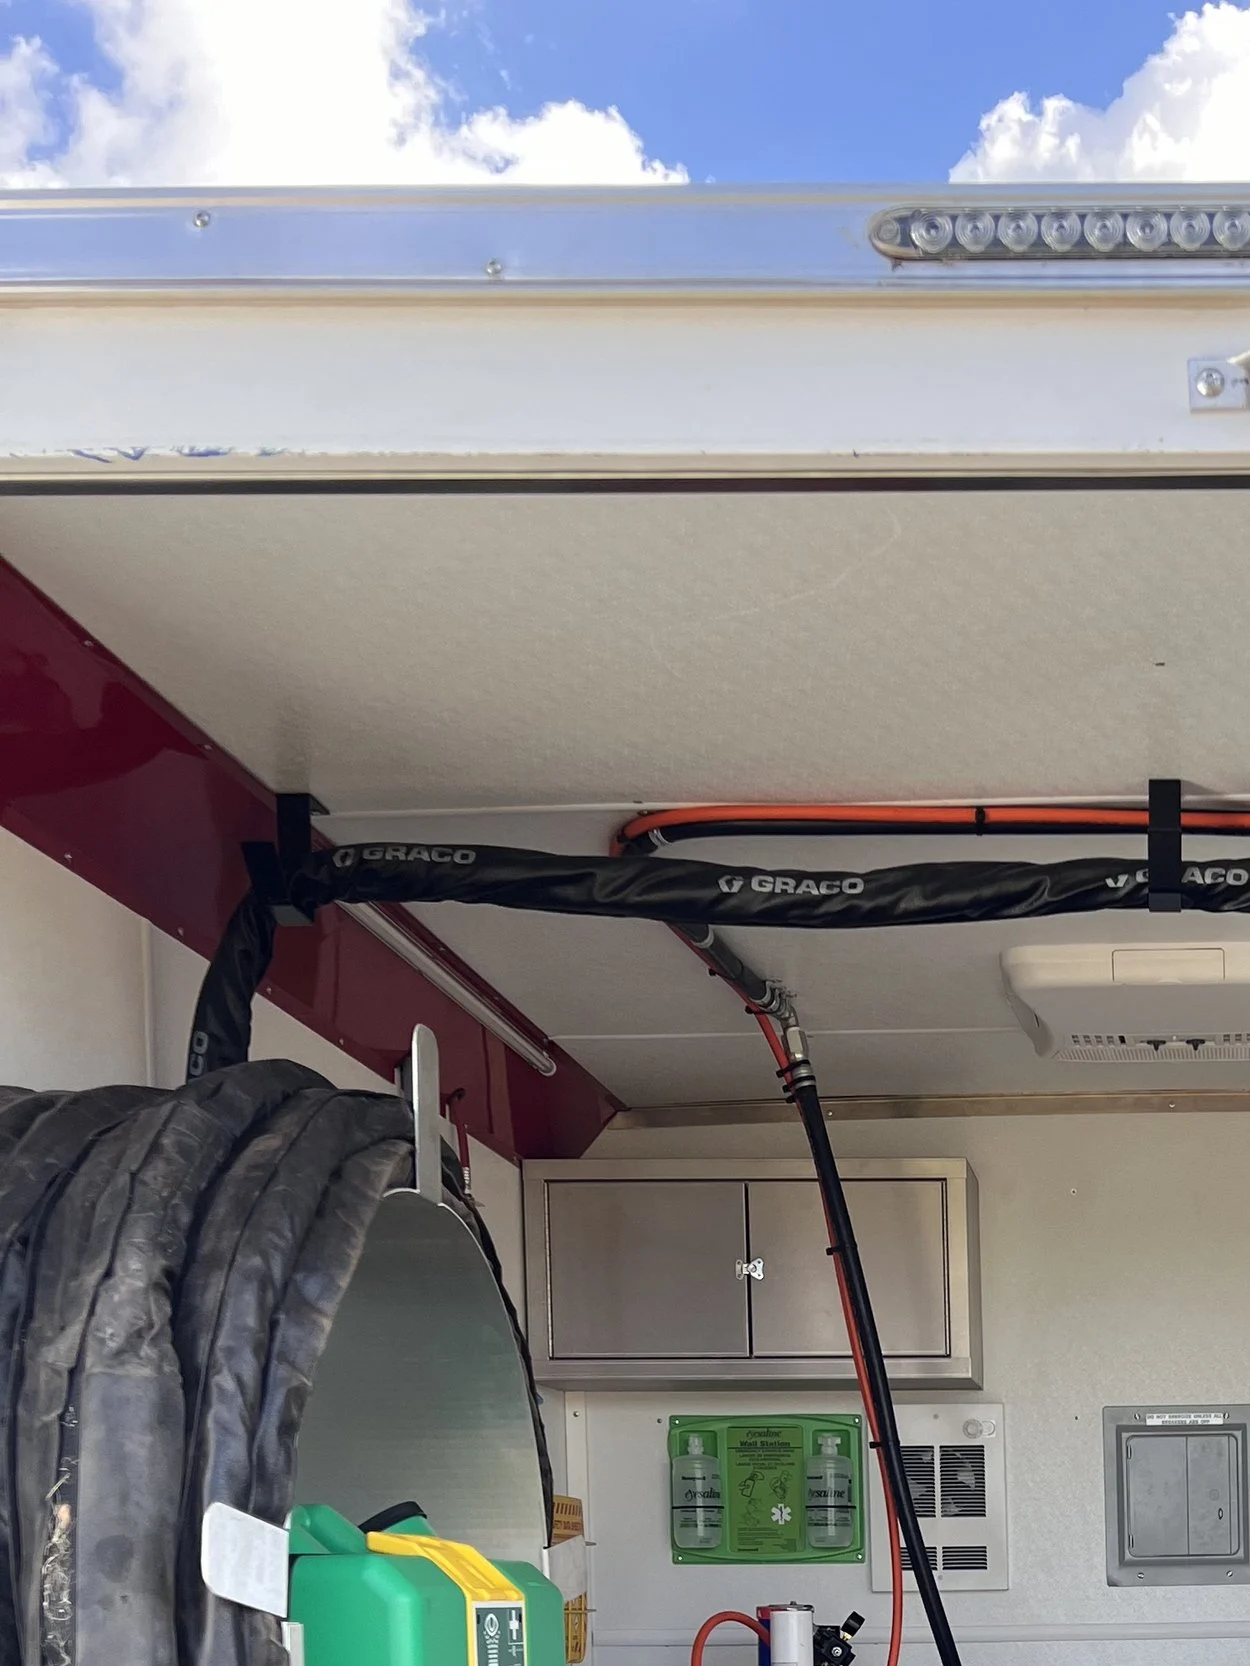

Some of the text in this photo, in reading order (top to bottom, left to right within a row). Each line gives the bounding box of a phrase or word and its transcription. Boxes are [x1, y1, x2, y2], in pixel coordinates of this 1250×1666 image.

[362, 846, 477, 866] GRACO
[750, 875, 866, 897] GRACO
[1136, 866, 1249, 887] GACO
